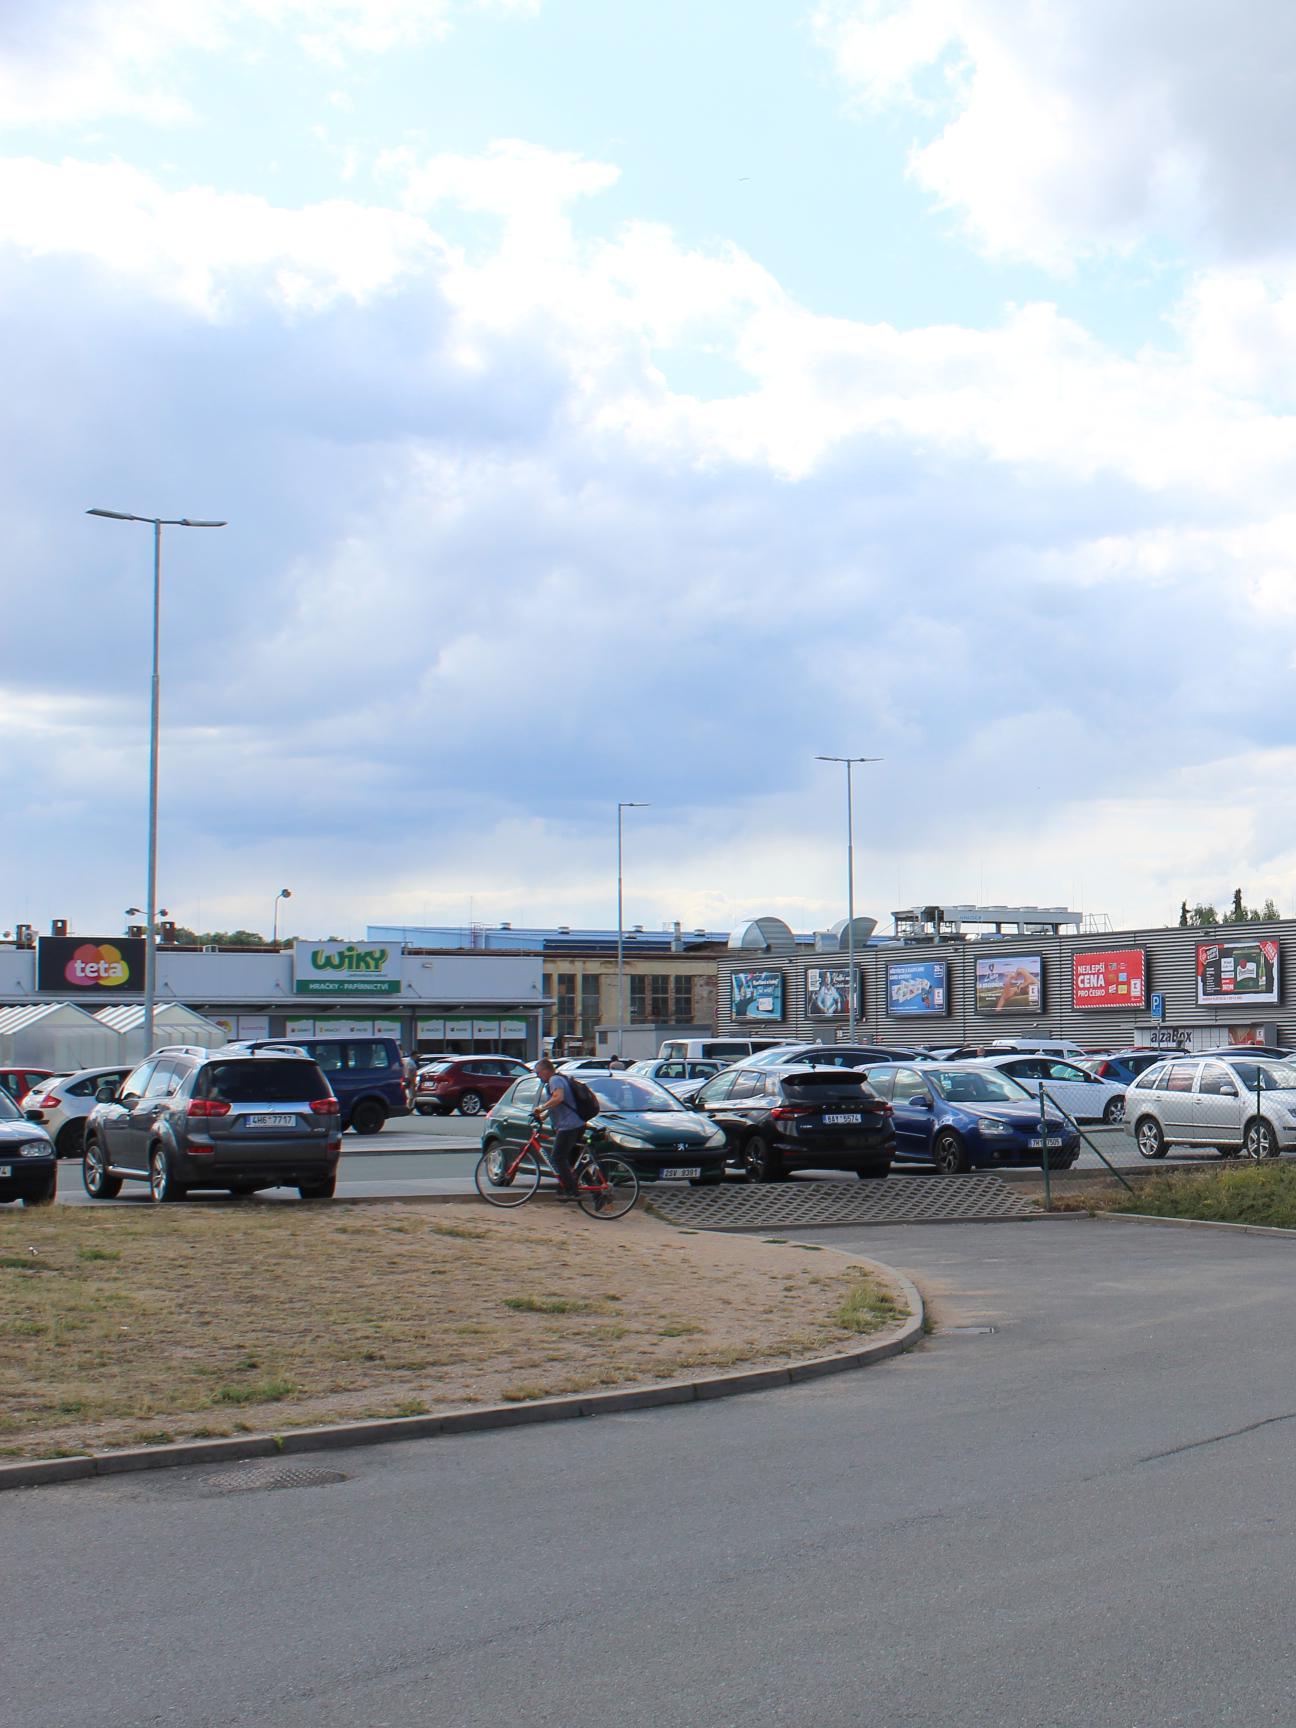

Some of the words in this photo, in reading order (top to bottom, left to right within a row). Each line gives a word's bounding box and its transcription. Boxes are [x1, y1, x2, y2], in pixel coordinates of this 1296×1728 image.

[74, 959, 123, 978] teta
[1077, 962, 1105, 973] NEJLEPŠÍ
[1077, 974, 1105, 988] CENA
[1089, 988, 1106, 997] ČESKO
[1153, 996, 1160, 1010] P
[273, 1115, 292, 1124] 7717
